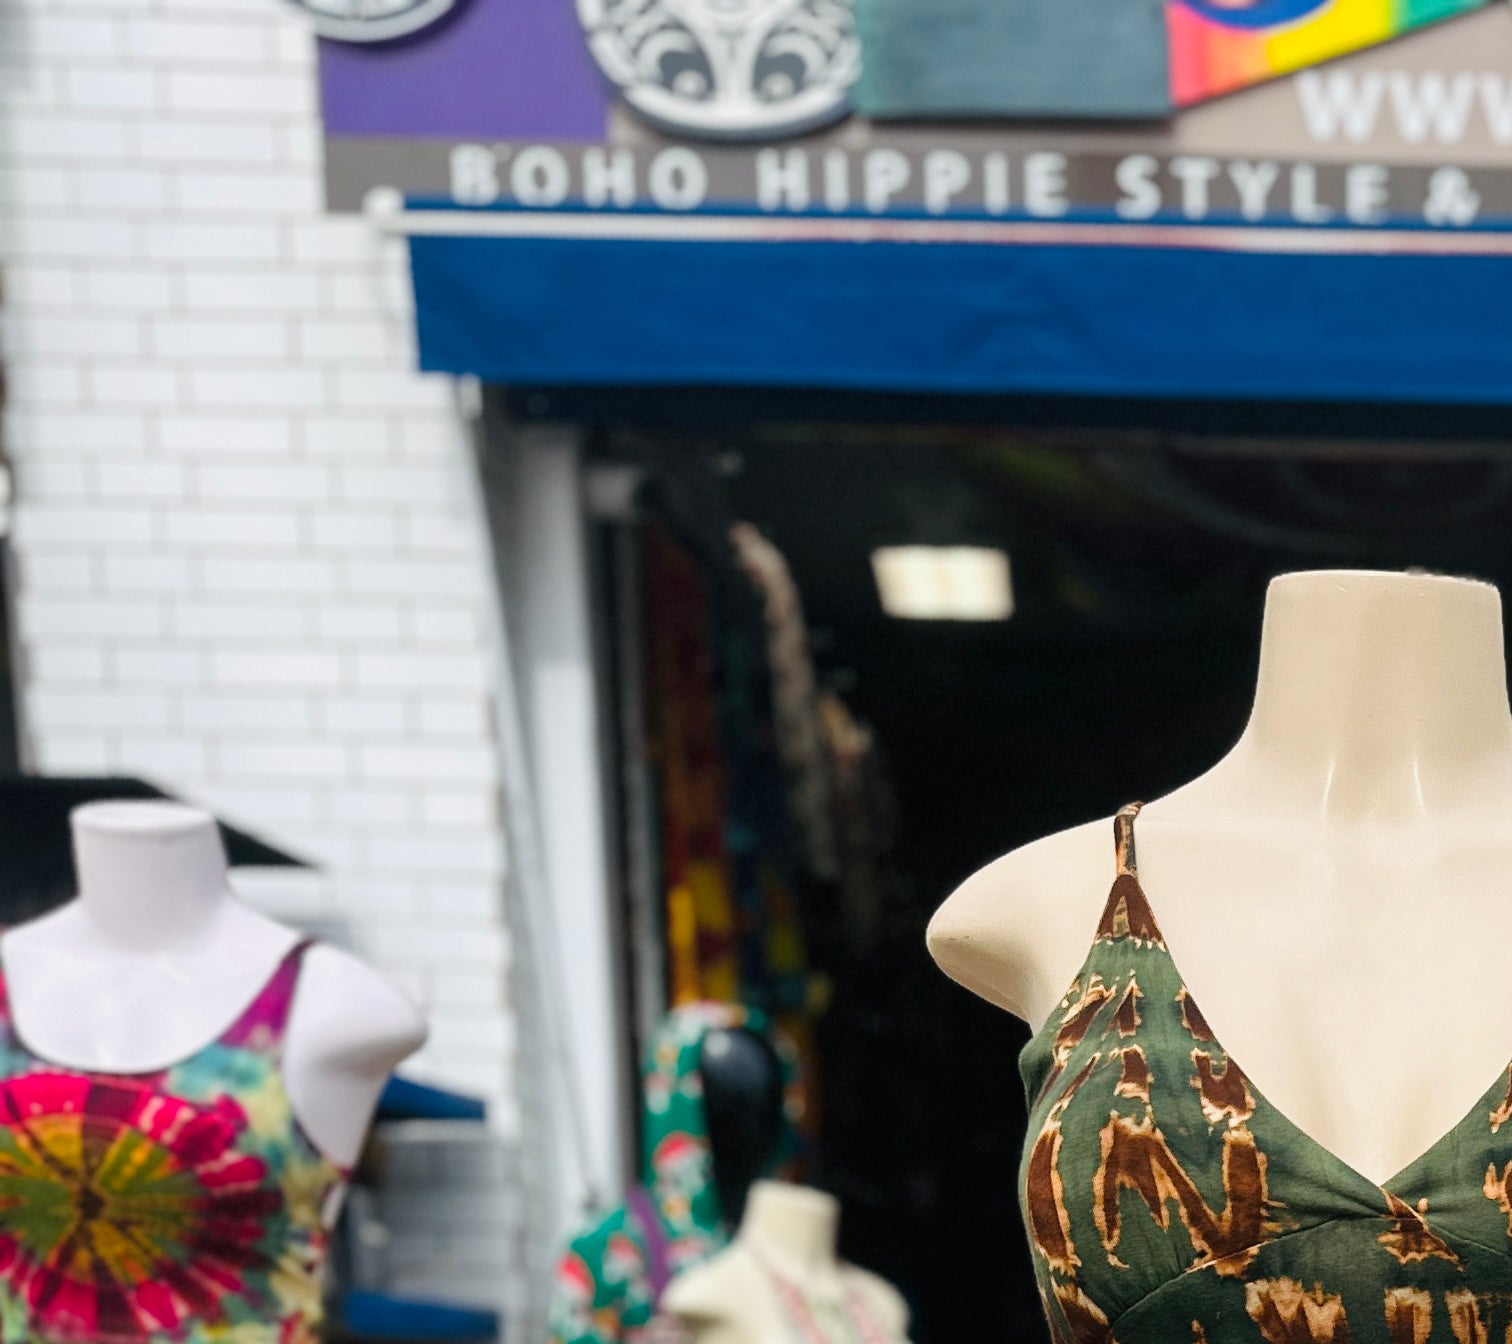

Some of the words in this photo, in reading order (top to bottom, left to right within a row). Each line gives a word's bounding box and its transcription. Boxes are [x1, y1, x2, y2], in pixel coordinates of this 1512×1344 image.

[449, 143, 707, 210] BOHO
[755, 147, 1069, 218] HIPPIE
[1115, 153, 1391, 223] STYLE
[1423, 165, 1481, 227] &
